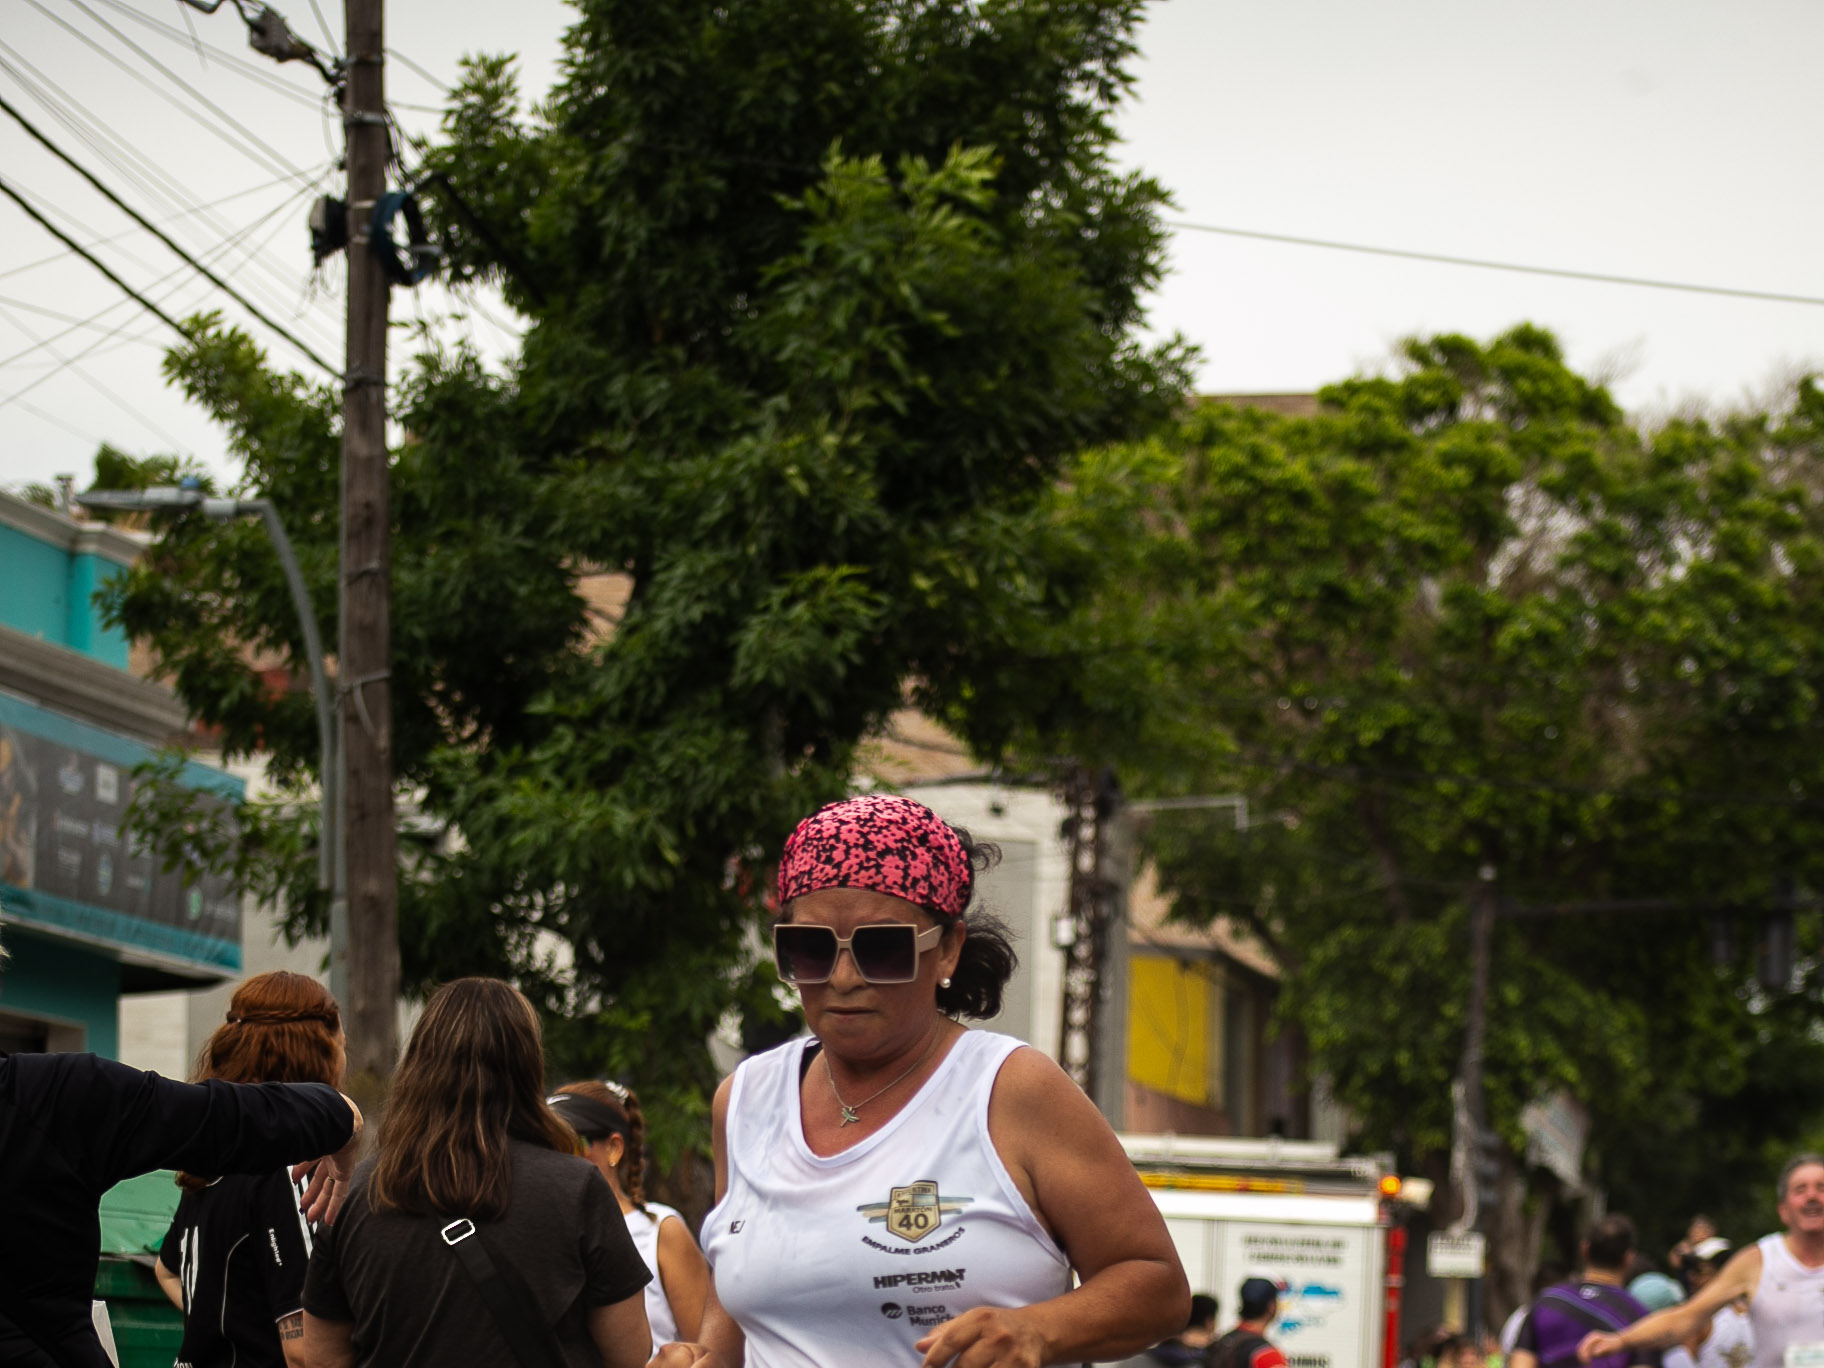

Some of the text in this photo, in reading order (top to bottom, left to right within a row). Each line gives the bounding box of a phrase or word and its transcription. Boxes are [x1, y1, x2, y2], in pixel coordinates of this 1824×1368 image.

[898, 1213, 929, 1230] 40
[862, 1227, 966, 1255] EMPALME GRANEROS
[873, 1268, 966, 1289] HIPERMAT
[906, 1305, 946, 1316] Banco
